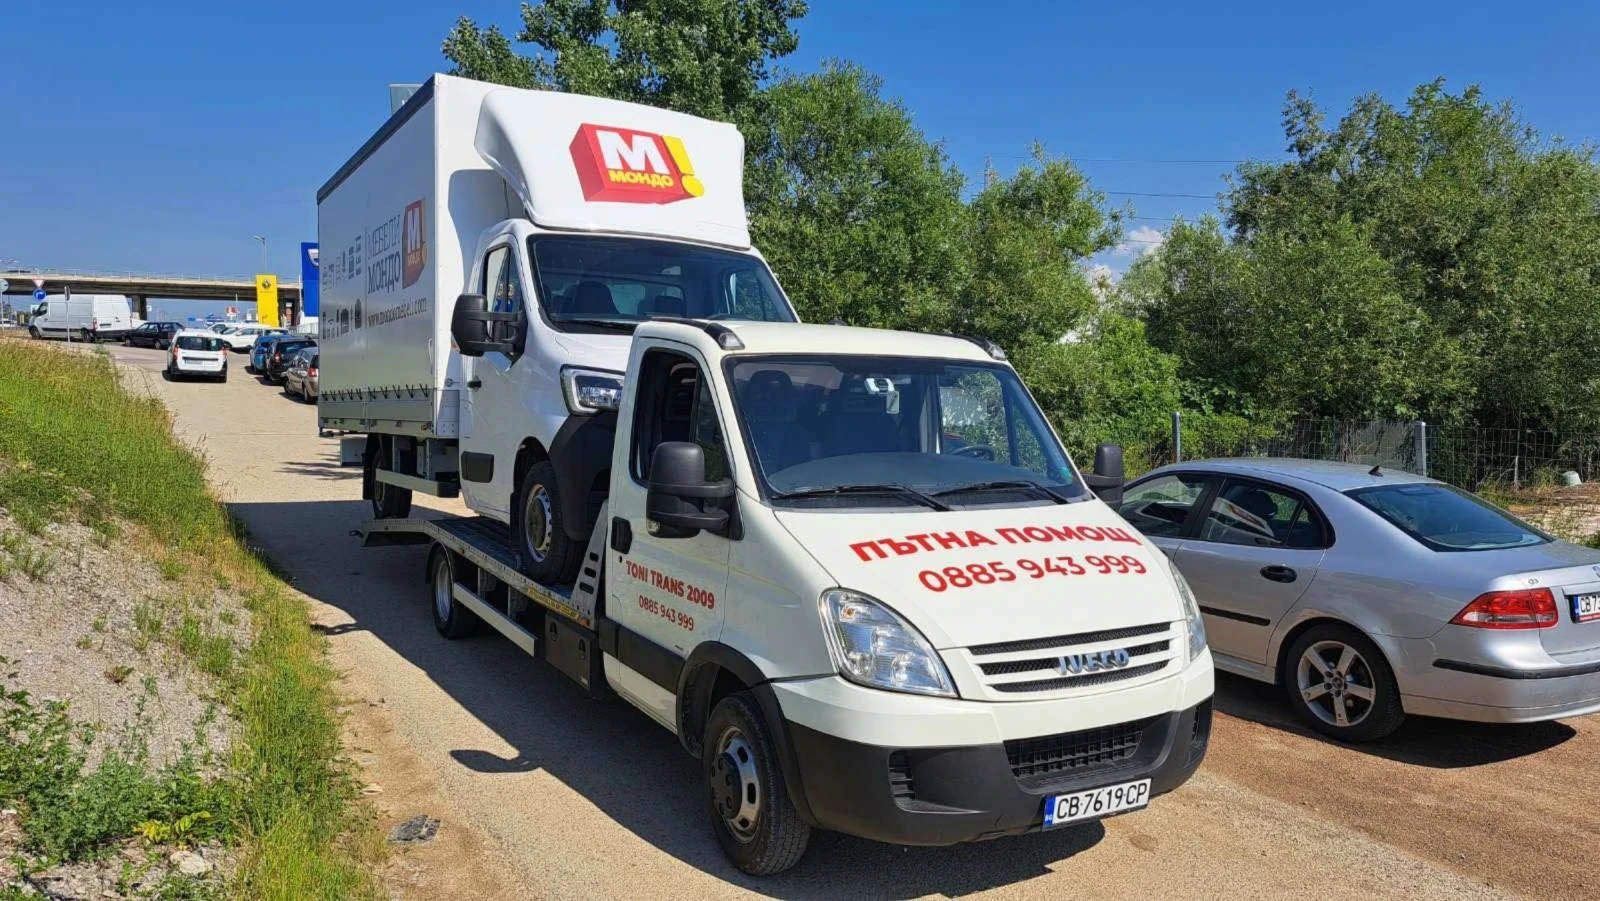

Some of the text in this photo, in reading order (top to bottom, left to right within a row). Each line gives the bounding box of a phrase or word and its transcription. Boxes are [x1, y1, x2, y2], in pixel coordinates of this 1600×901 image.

[607, 170, 674, 188] МОНДО
[367, 250, 401, 295] МОНДО
[849, 526, 1143, 562] ПЪТНА ПОМОЩ
[626, 560, 715, 609] TONI TRANS 2009
[918, 555, 1147, 592] 0885 943 999
[639, 595, 694, 631] 0885 943 999
[1057, 648, 1131, 676] IVECO
